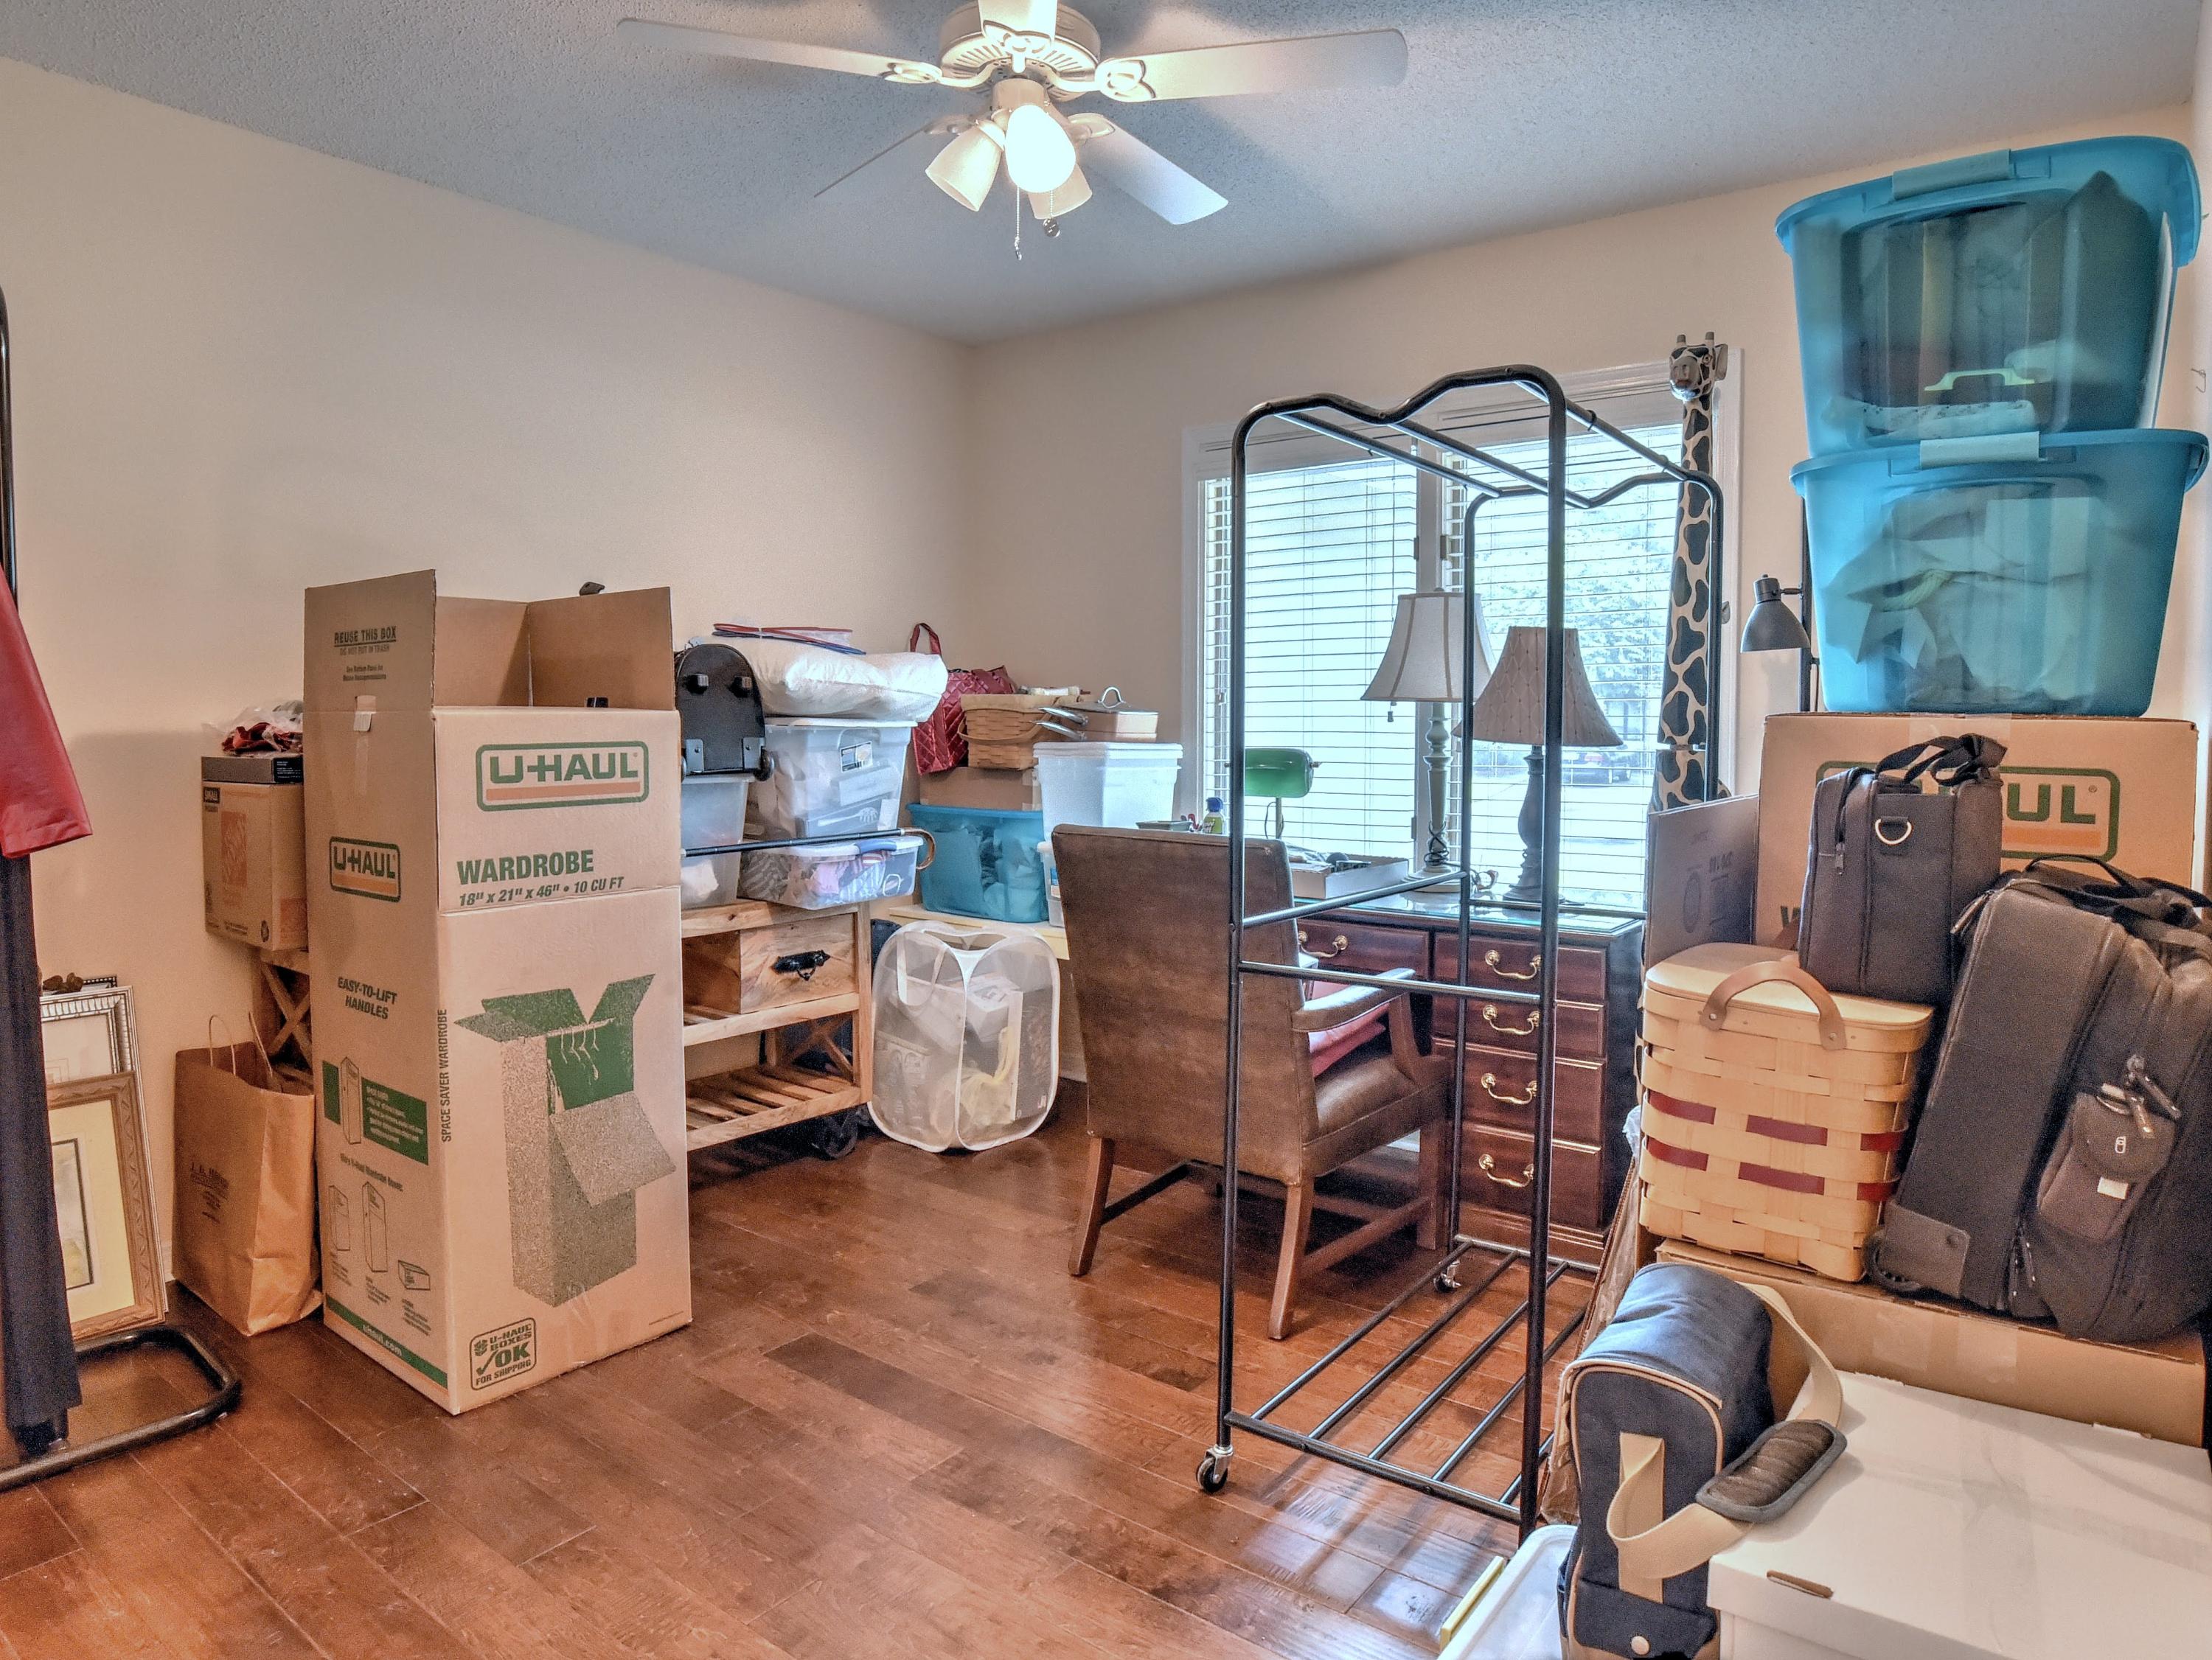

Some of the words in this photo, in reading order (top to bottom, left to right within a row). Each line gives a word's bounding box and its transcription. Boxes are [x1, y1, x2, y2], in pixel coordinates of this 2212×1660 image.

[334, 630, 358, 644] REUSE
[361, 629, 378, 641] THIS
[380, 625, 397, 639] BOX
[490, 752, 639, 784] U-HAUL
[333, 845, 396, 879] U-HAUL
[456, 849, 594, 885] WARDROBE
[459, 891, 484, 907] 18"
[486, 893, 494, 904] x
[498, 888, 522, 902] 21"
[524, 889, 533, 899] x
[536, 884, 560, 898] 46"
[574, 881, 588, 893] 10
[591, 879, 607, 892] CU
[609, 876, 625, 889] FT
[338, 977, 397, 1005] EASY-TO-LIFT
[345, 995, 389, 1019] HANDLES
[437, 1009, 449, 1070] WARDROBE
[439, 1072, 451, 1106] SAVER
[440, 1107, 451, 1143] SPACE
[490, 1323, 532, 1344] U-HAUL
[490, 1331, 532, 1351] BOXES
[495, 1342, 531, 1367] OK
[476, 1374, 492, 1386] FOR
[494, 1359, 531, 1379] SHIPPING
